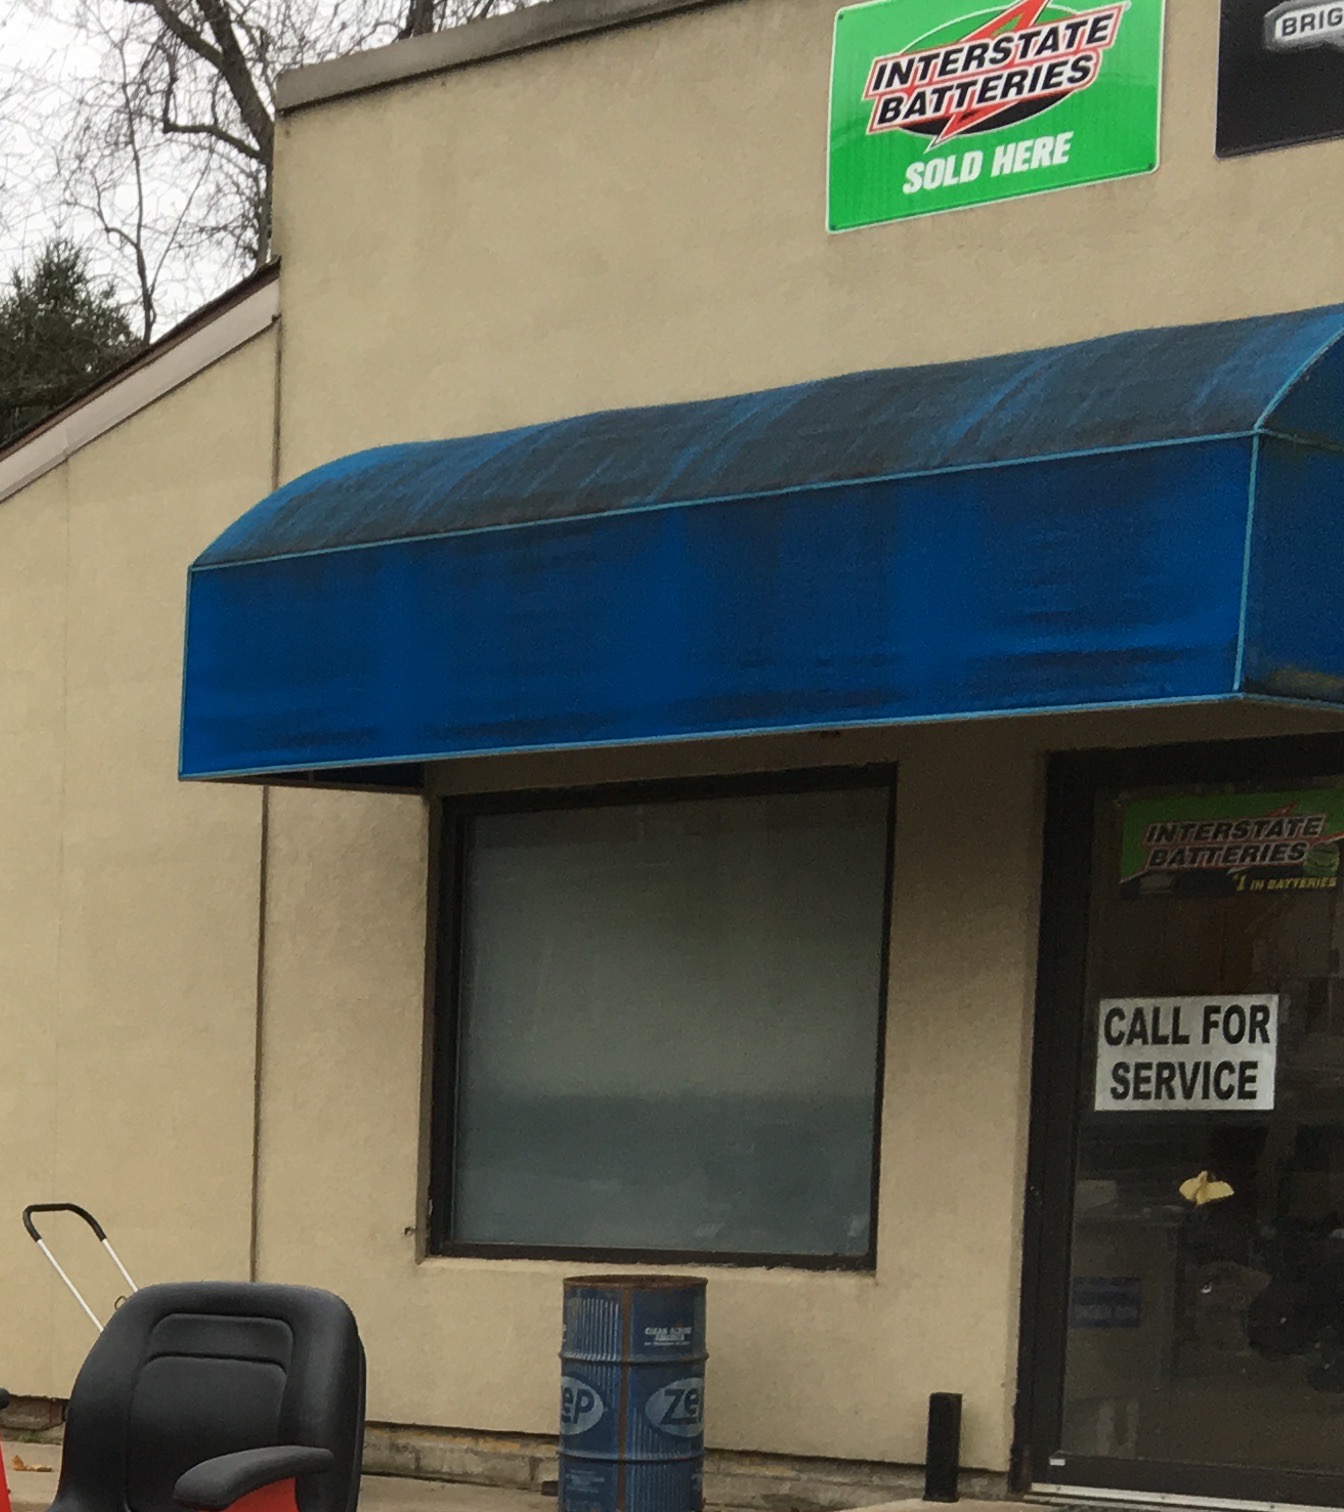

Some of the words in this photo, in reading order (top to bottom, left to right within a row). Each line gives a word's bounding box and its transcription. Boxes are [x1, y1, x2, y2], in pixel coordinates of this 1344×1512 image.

[871, 12, 1116, 92] INTERSTATE
[876, 54, 1095, 126] BATTERIES
[903, 150, 985, 195] SOLD
[991, 131, 1075, 179] HERE
[1146, 817, 1323, 843] INTERSTATE
[1148, 842, 1308, 867] BATTERIES
[1104, 1007, 1190, 1046] CALL
[1202, 1004, 1271, 1045] FOR
[1109, 1060, 1259, 1101] SERVICE
